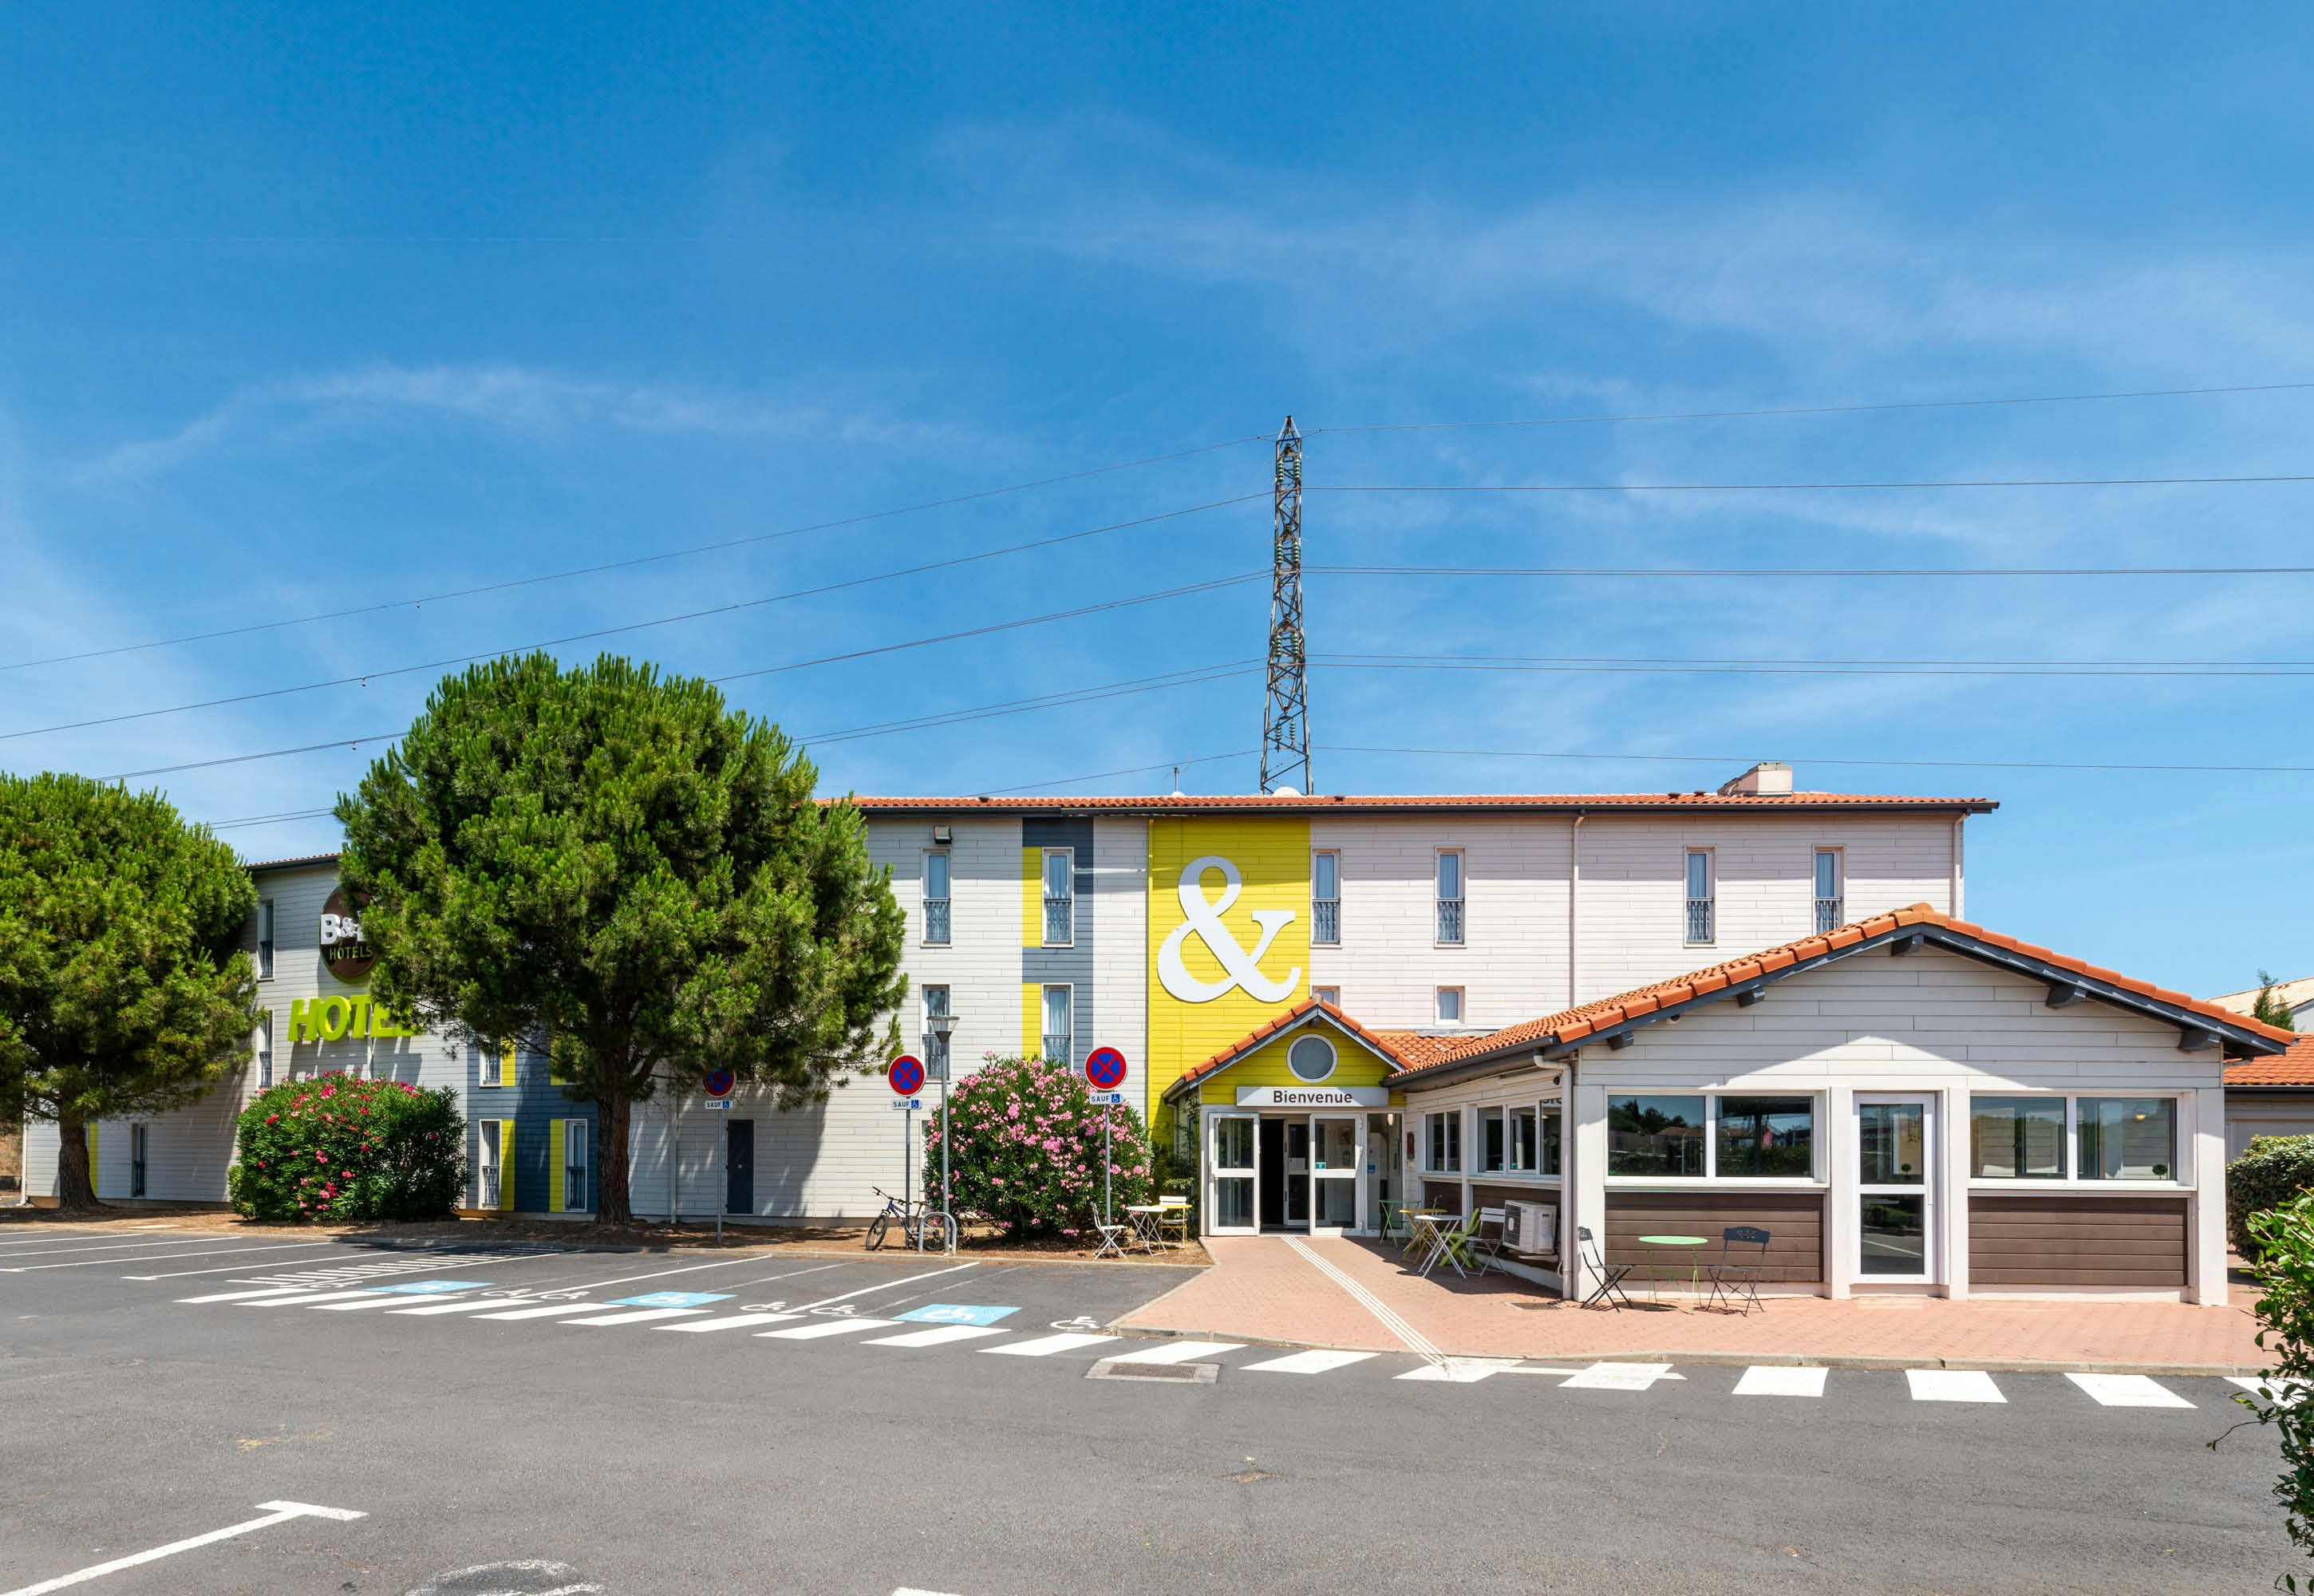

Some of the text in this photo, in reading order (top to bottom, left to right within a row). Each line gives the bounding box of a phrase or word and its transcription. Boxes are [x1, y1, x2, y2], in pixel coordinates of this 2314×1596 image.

[1157, 855, 1301, 1003] &
[329, 946, 373, 960] HOTELS
[1273, 1090, 1352, 1104] Bienvenue
